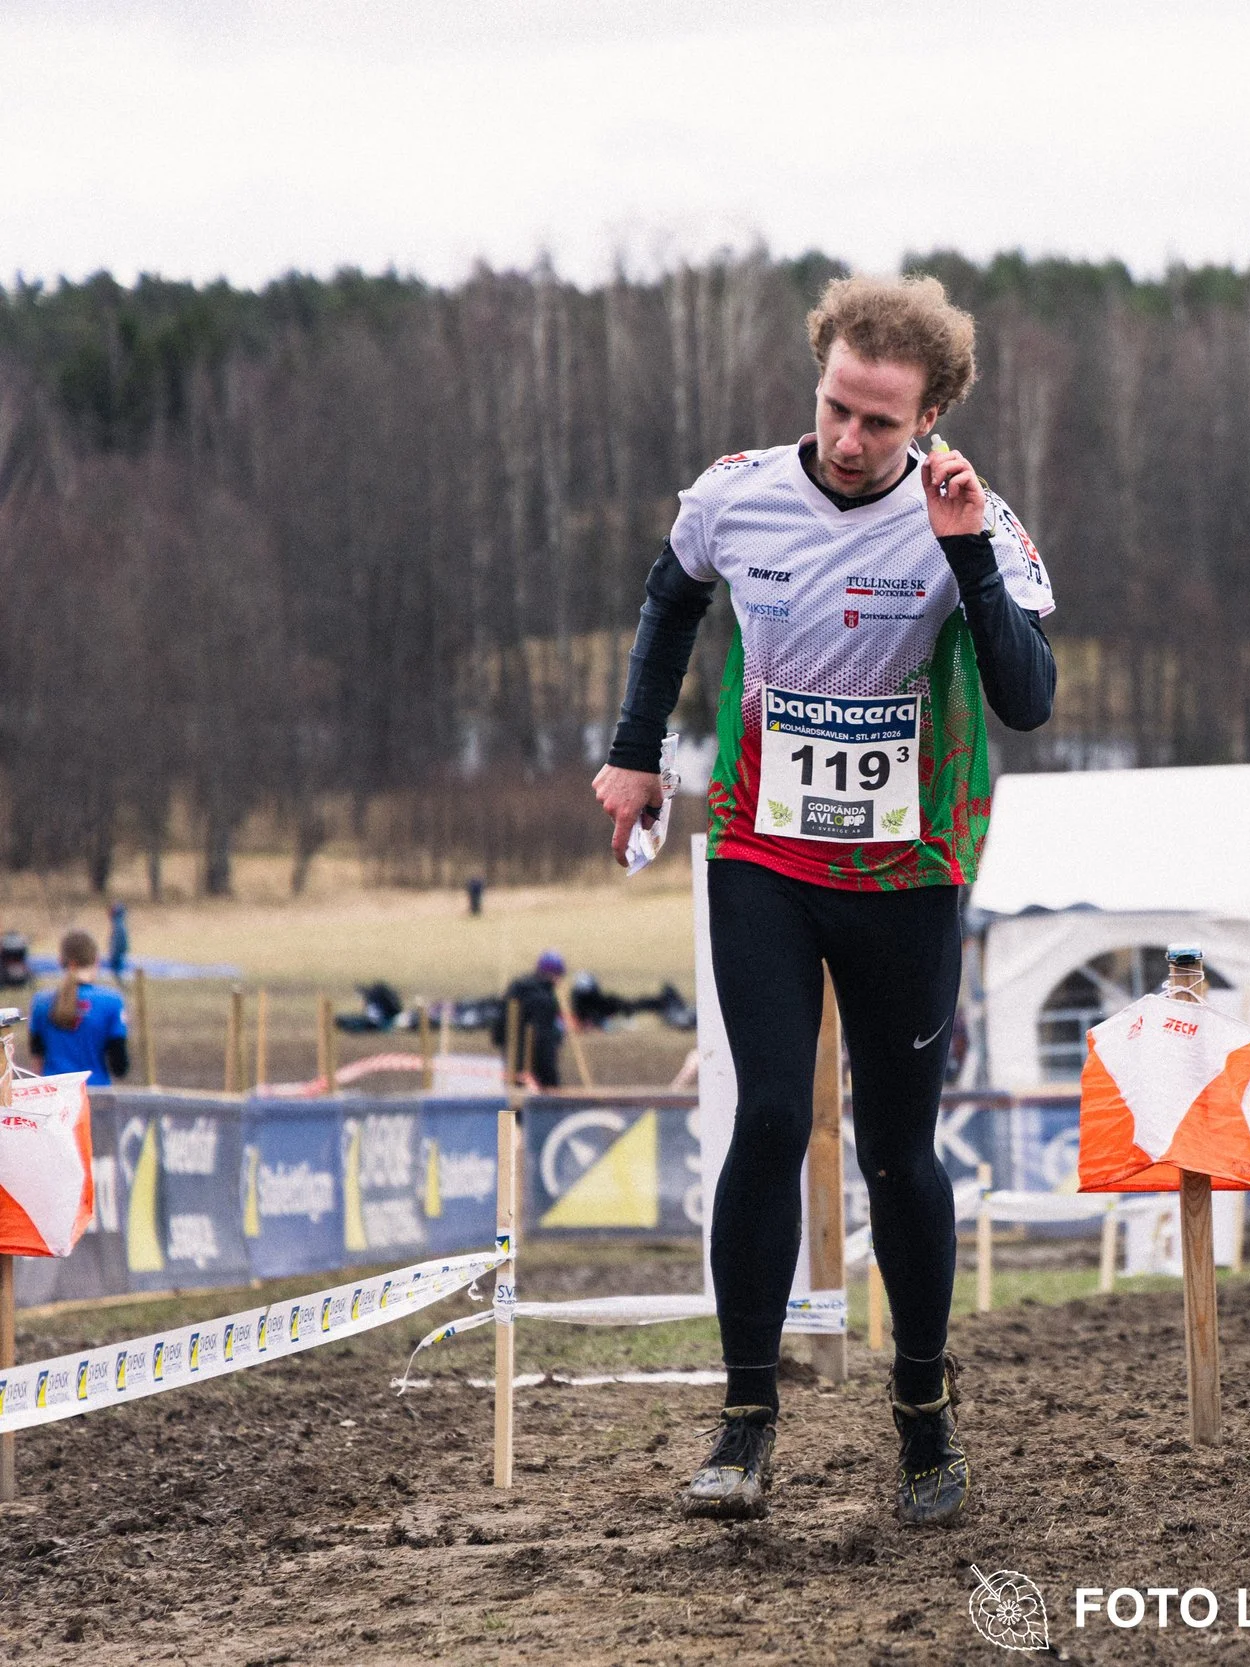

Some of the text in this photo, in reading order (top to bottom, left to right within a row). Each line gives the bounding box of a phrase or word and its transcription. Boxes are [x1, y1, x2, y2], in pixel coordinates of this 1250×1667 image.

[747, 567, 792, 582] TRIMTEX
[847, 576, 926, 590] TULLINGE SK
[768, 691, 916, 725] bagheera
[780, 722, 849, 740] KOLMÅRDSKAVLEN
[855, 733, 869, 741] STL
[882, 730, 901, 739] 2026
[791, 744, 891, 792] 119
[808, 802, 867, 815] GODKÄNDA
